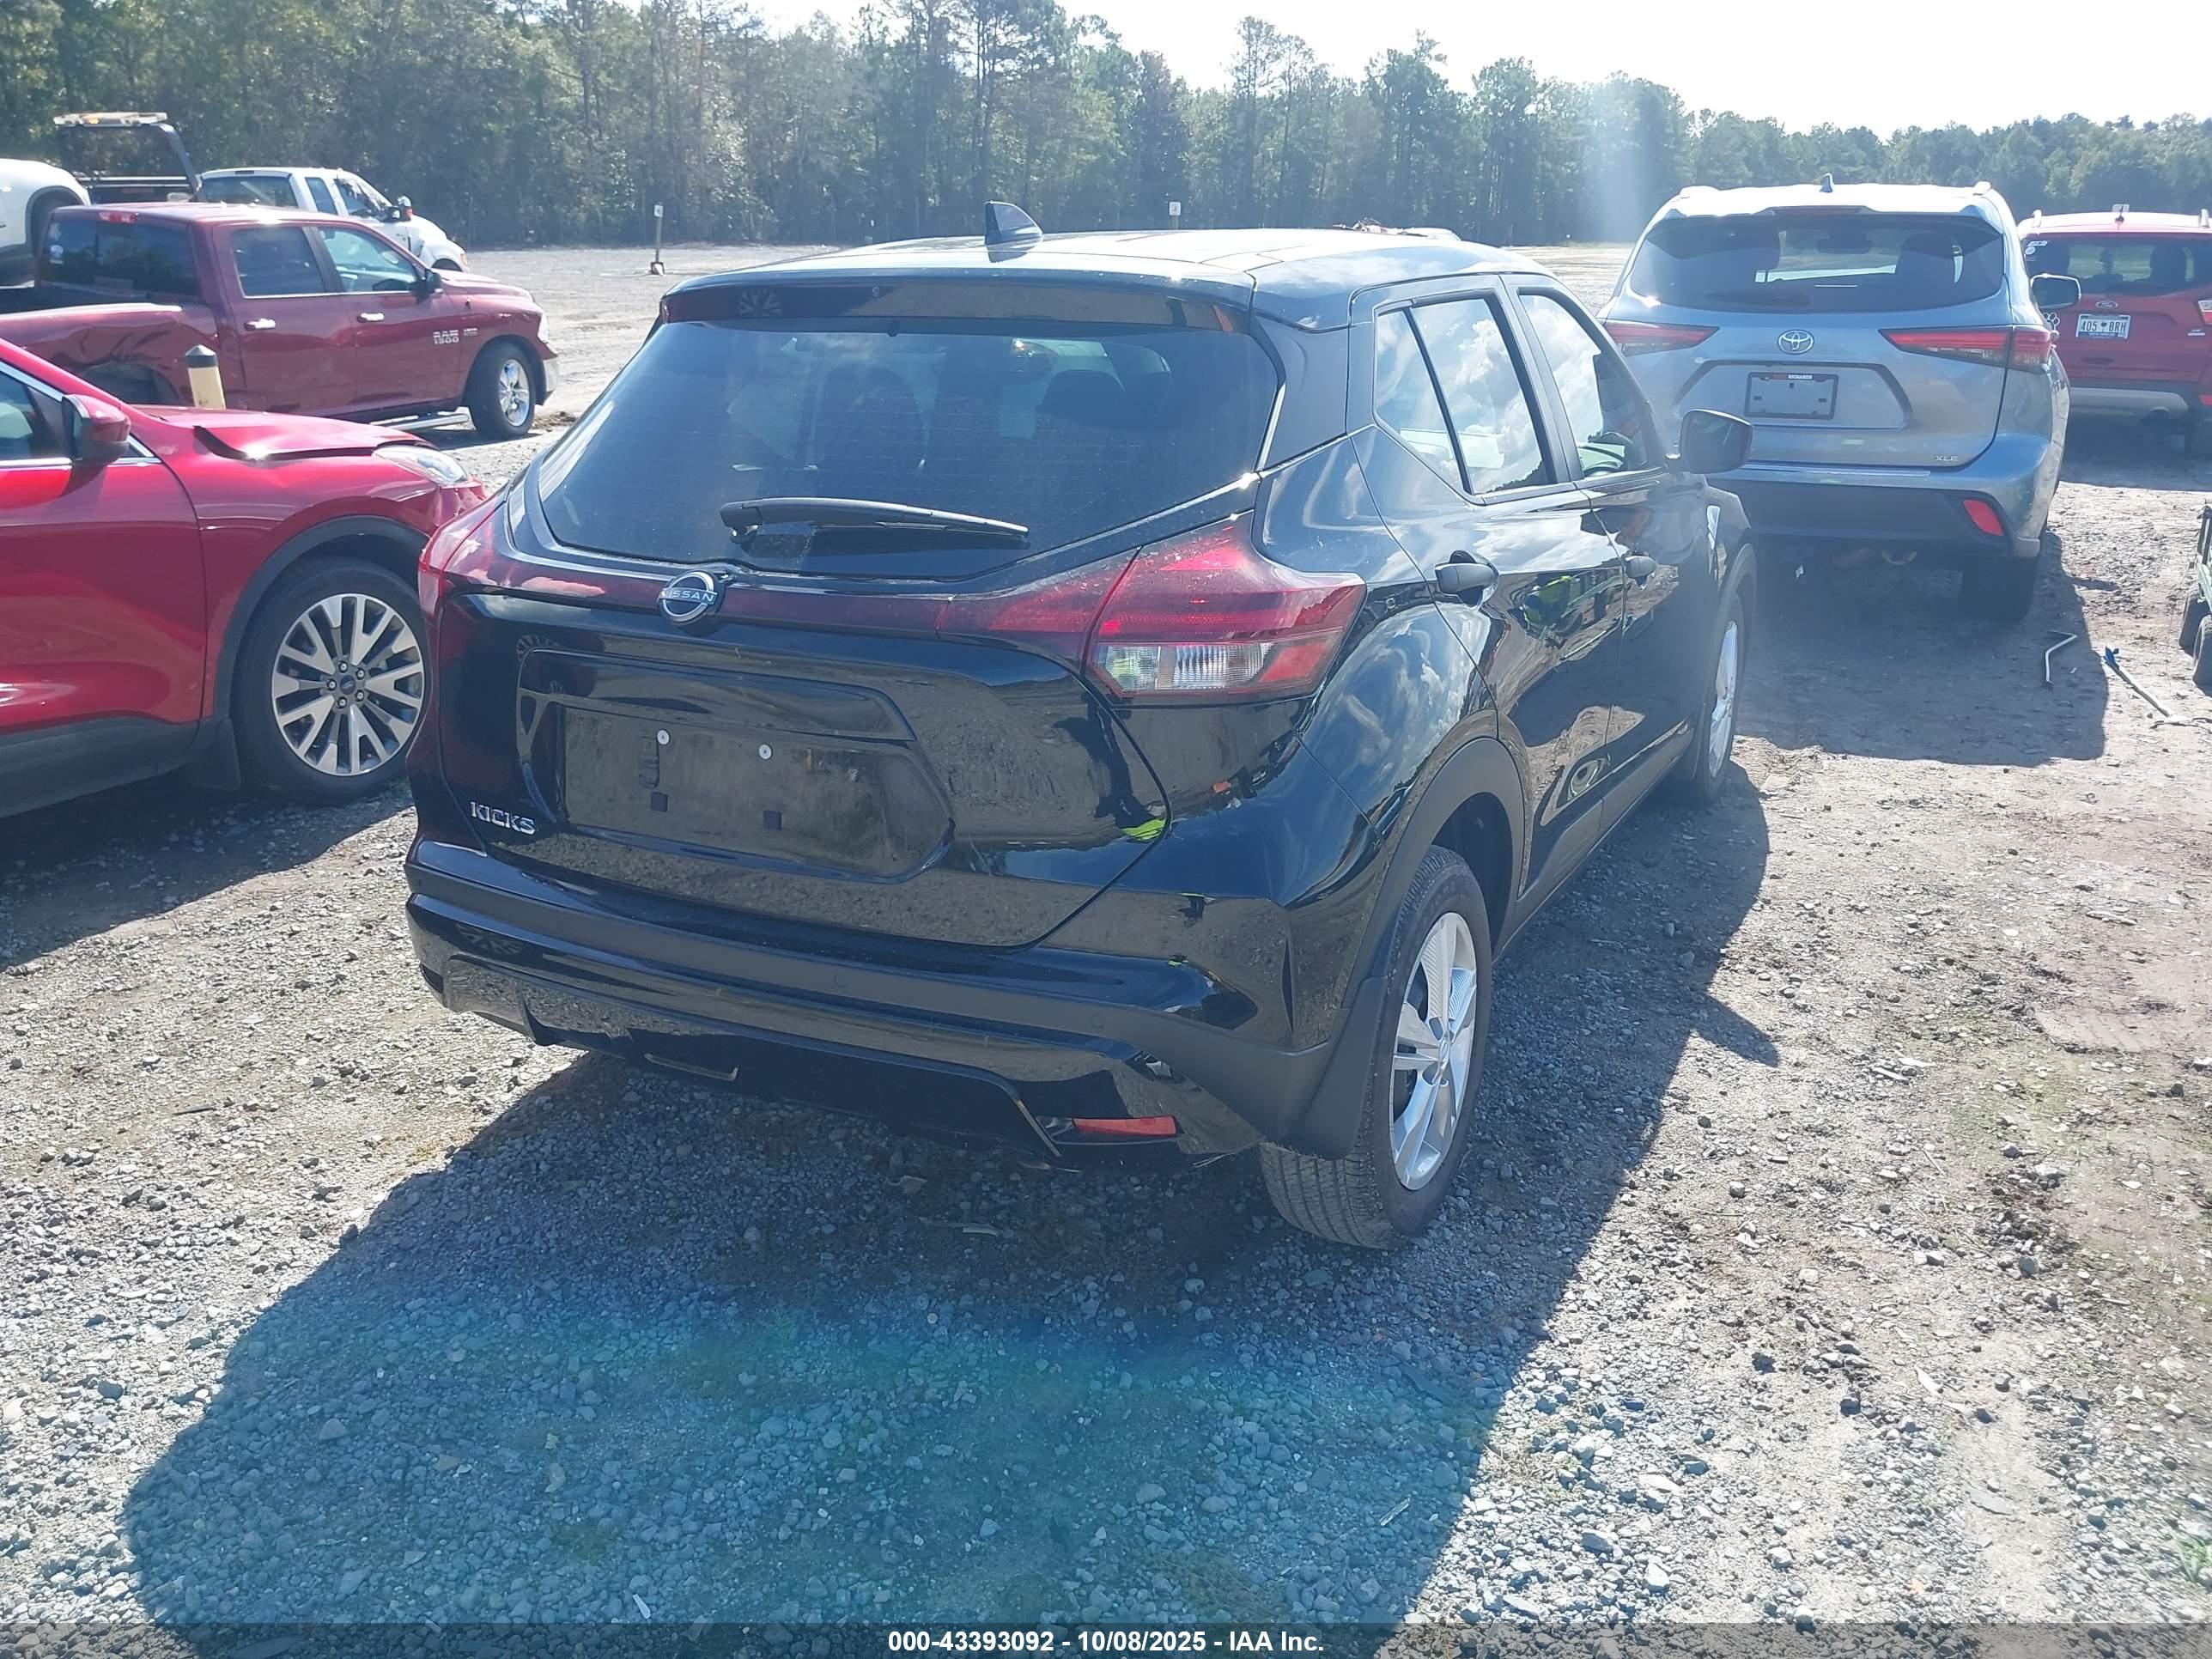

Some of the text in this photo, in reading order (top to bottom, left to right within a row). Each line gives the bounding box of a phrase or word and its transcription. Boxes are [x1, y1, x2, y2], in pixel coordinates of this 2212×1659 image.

[2081, 321, 2098, 331] 405
[660, 588, 714, 603] NISSAN
[469, 801, 536, 836] KICKS
